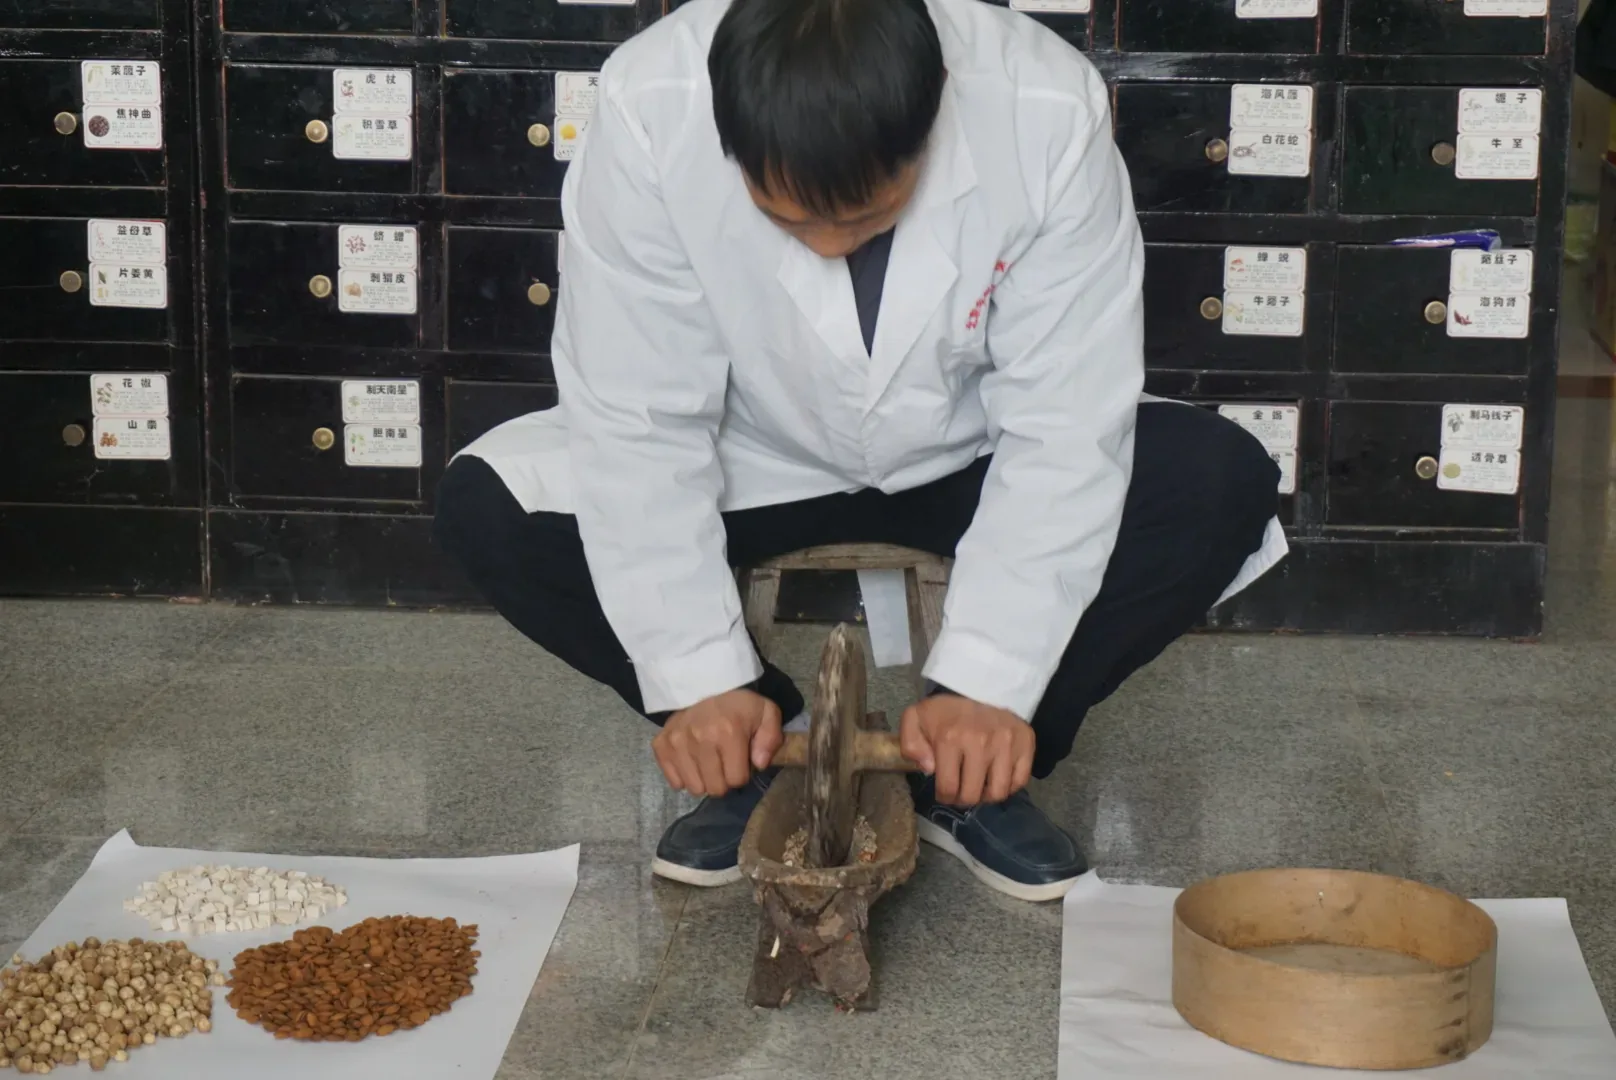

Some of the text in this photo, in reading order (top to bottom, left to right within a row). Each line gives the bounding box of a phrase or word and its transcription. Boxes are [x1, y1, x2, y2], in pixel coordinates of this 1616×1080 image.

[366, 74, 396, 85] 虎杖
[116, 108, 151, 119] 焦神曲
[363, 119, 397, 130] 积雪草
[1262, 134, 1298, 146] 白花蛇
[118, 225, 153, 237] 益母草
[119, 268, 153, 279] 片姜黄
[370, 272, 405, 284] 刺猬皮
[1480, 296, 1516, 307] 海狗肾
[122, 378, 151, 388] 花椒
[366, 384, 407, 395] 制天南星
[373, 427, 407, 439] 胆南星
[1471, 452, 1507, 464] 透骨草
